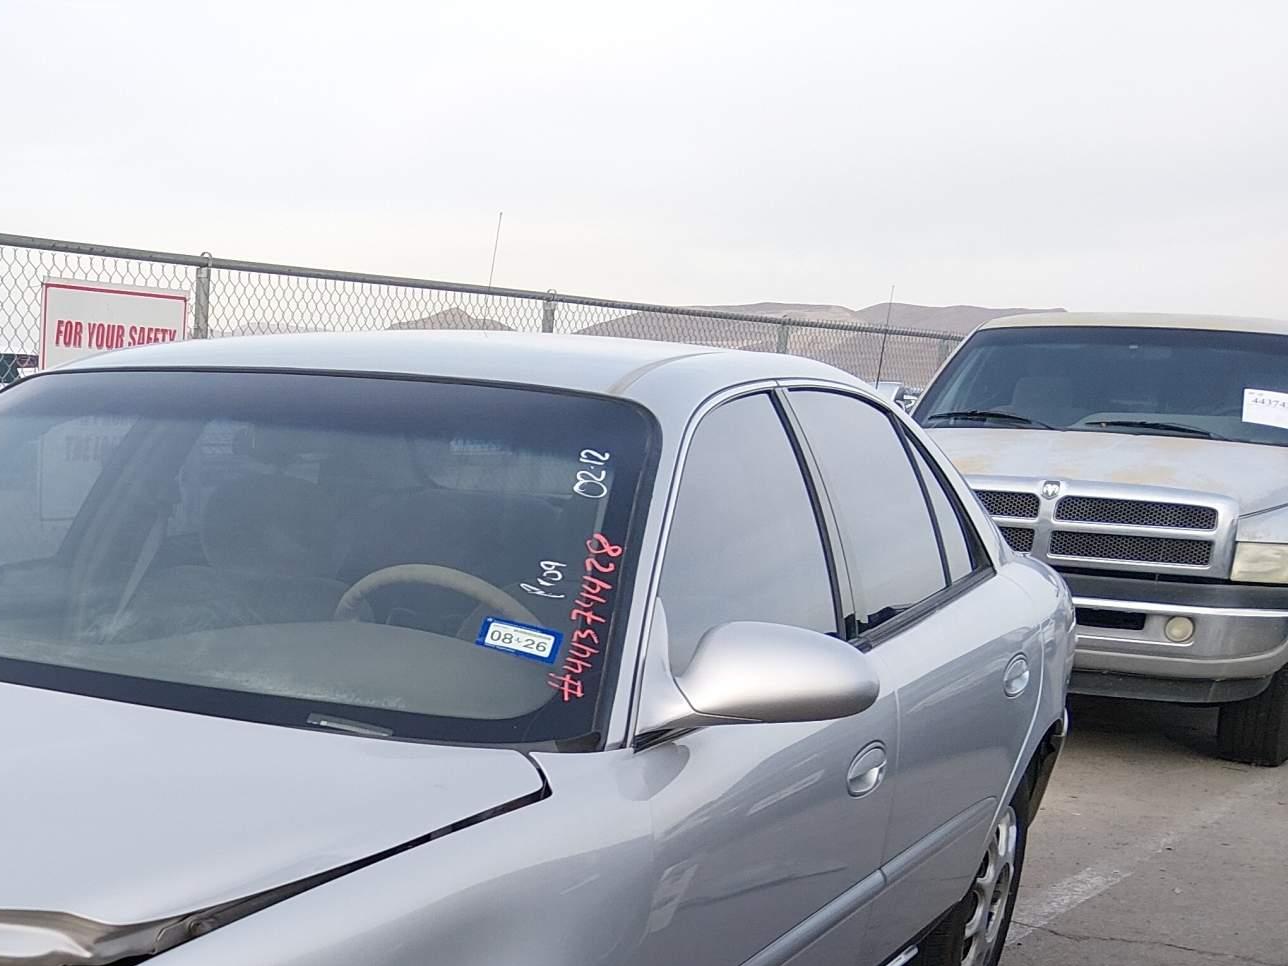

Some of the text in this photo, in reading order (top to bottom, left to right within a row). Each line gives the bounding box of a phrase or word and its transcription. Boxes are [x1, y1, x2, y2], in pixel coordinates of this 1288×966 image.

[55, 319, 176, 350] FOR YOUR SAFETY
[547, 532, 623, 702] #44374428
